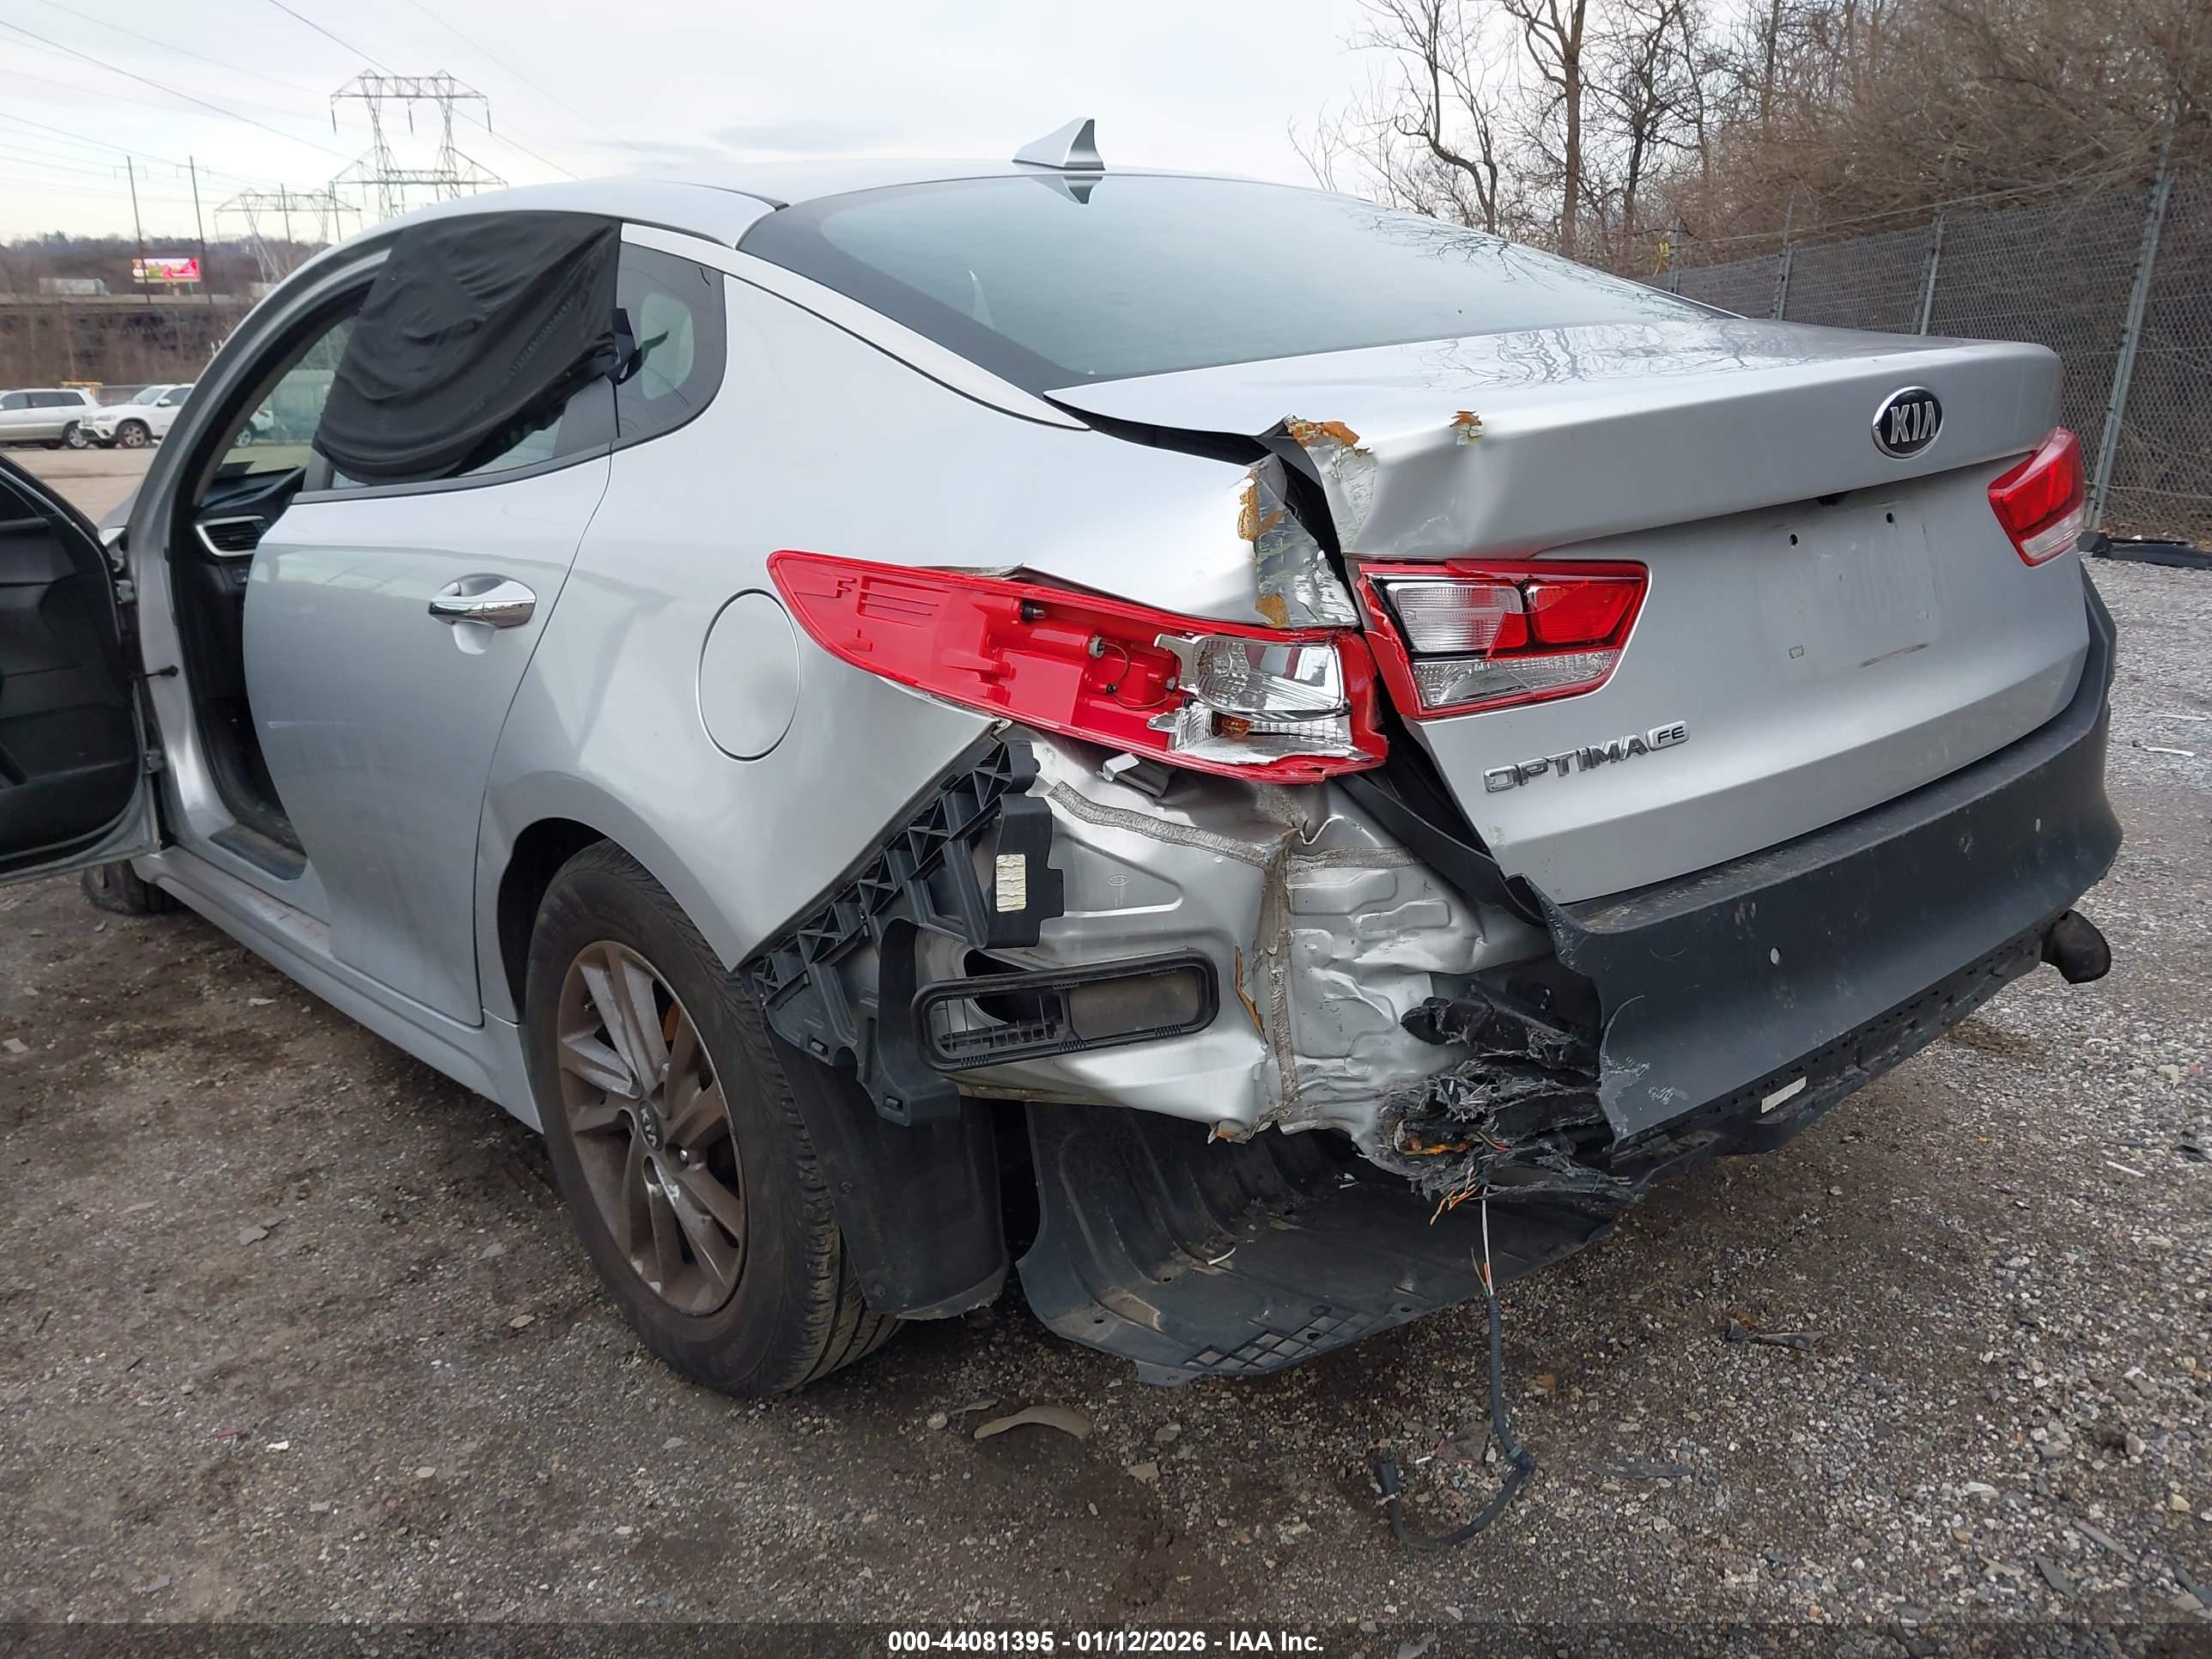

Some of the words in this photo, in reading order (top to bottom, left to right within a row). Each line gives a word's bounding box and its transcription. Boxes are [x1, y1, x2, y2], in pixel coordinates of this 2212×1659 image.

[1889, 400, 1936, 445] KIA
[1483, 734, 1650, 793] OPTIMA
[641, 1108, 658, 1148] KIA
